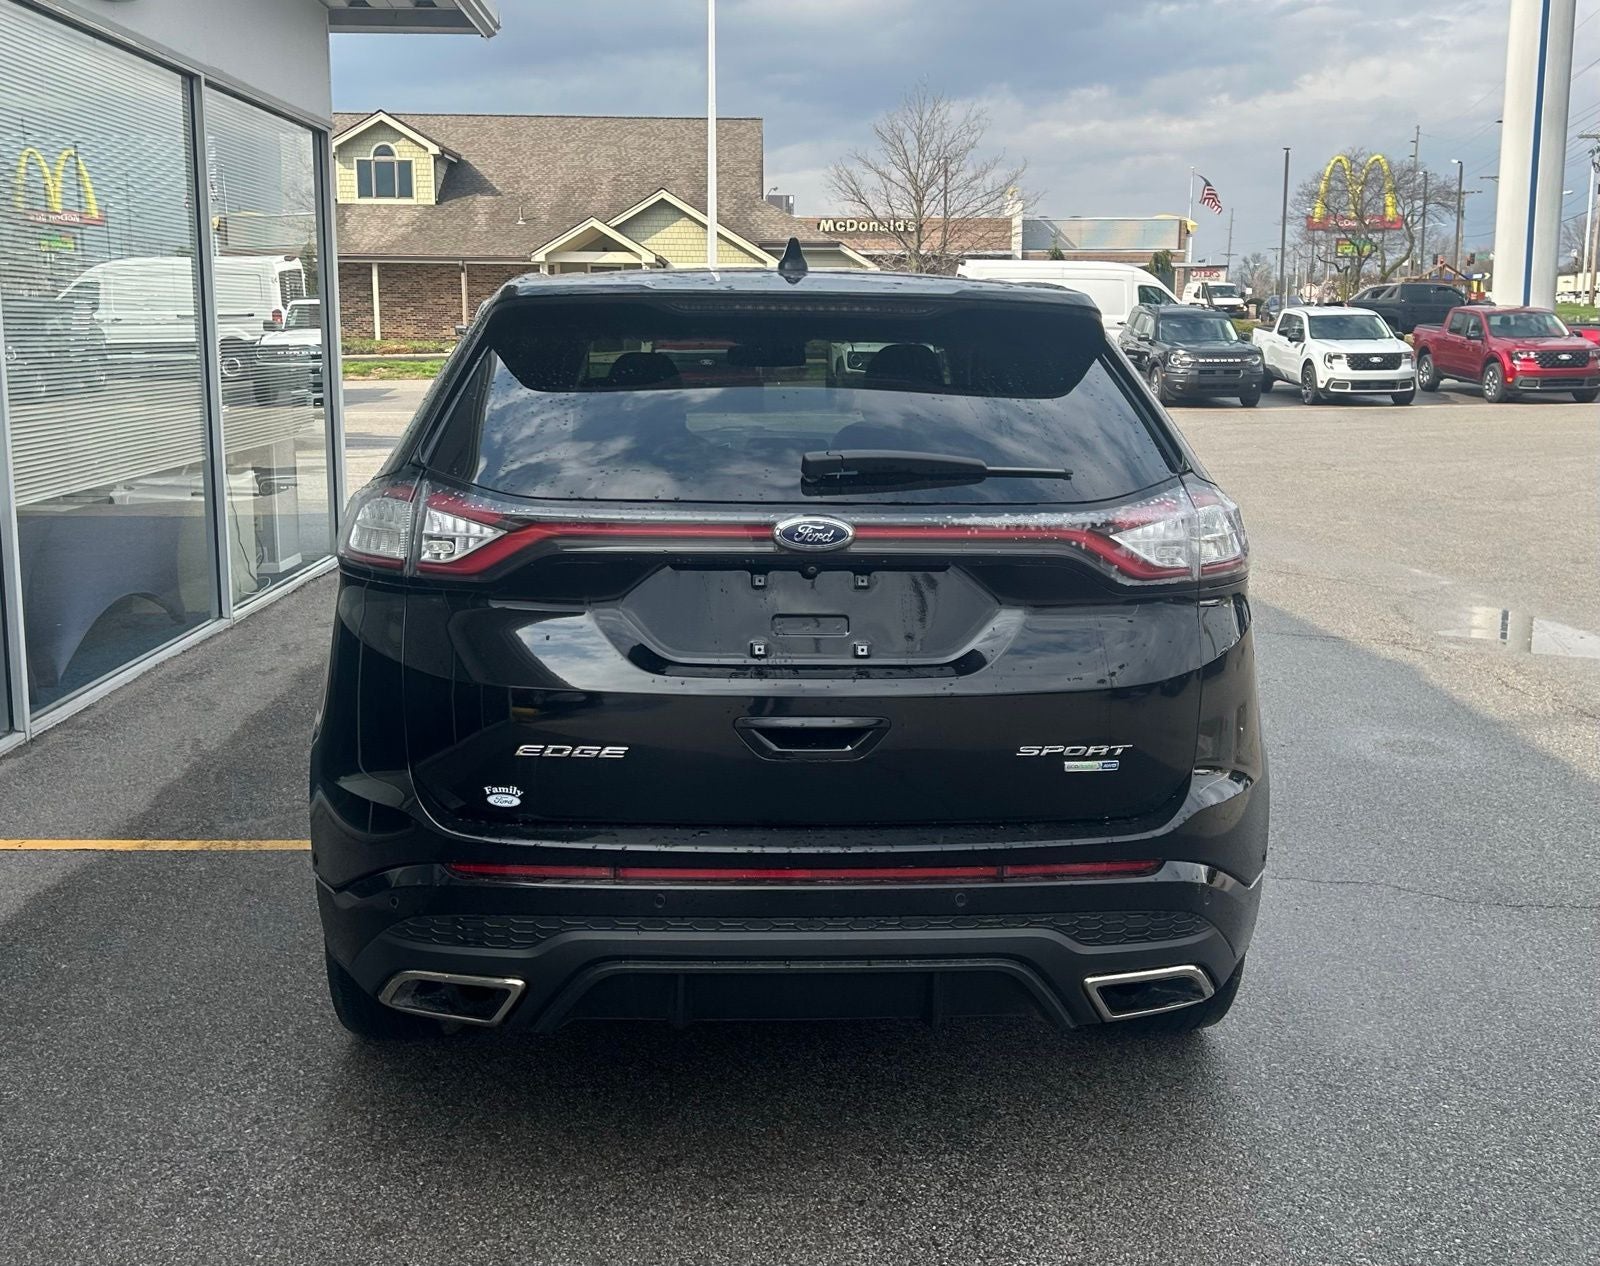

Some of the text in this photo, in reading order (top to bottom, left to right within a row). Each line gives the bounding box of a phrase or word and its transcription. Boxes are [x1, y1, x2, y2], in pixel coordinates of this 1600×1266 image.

[819, 219, 917, 232] McDonald's
[793, 524, 835, 542] Ford
[514, 744, 629, 758] EDGE
[1016, 744, 1133, 757] SPORT
[484, 785, 524, 798] Family
[493, 796, 514, 805] Ford
